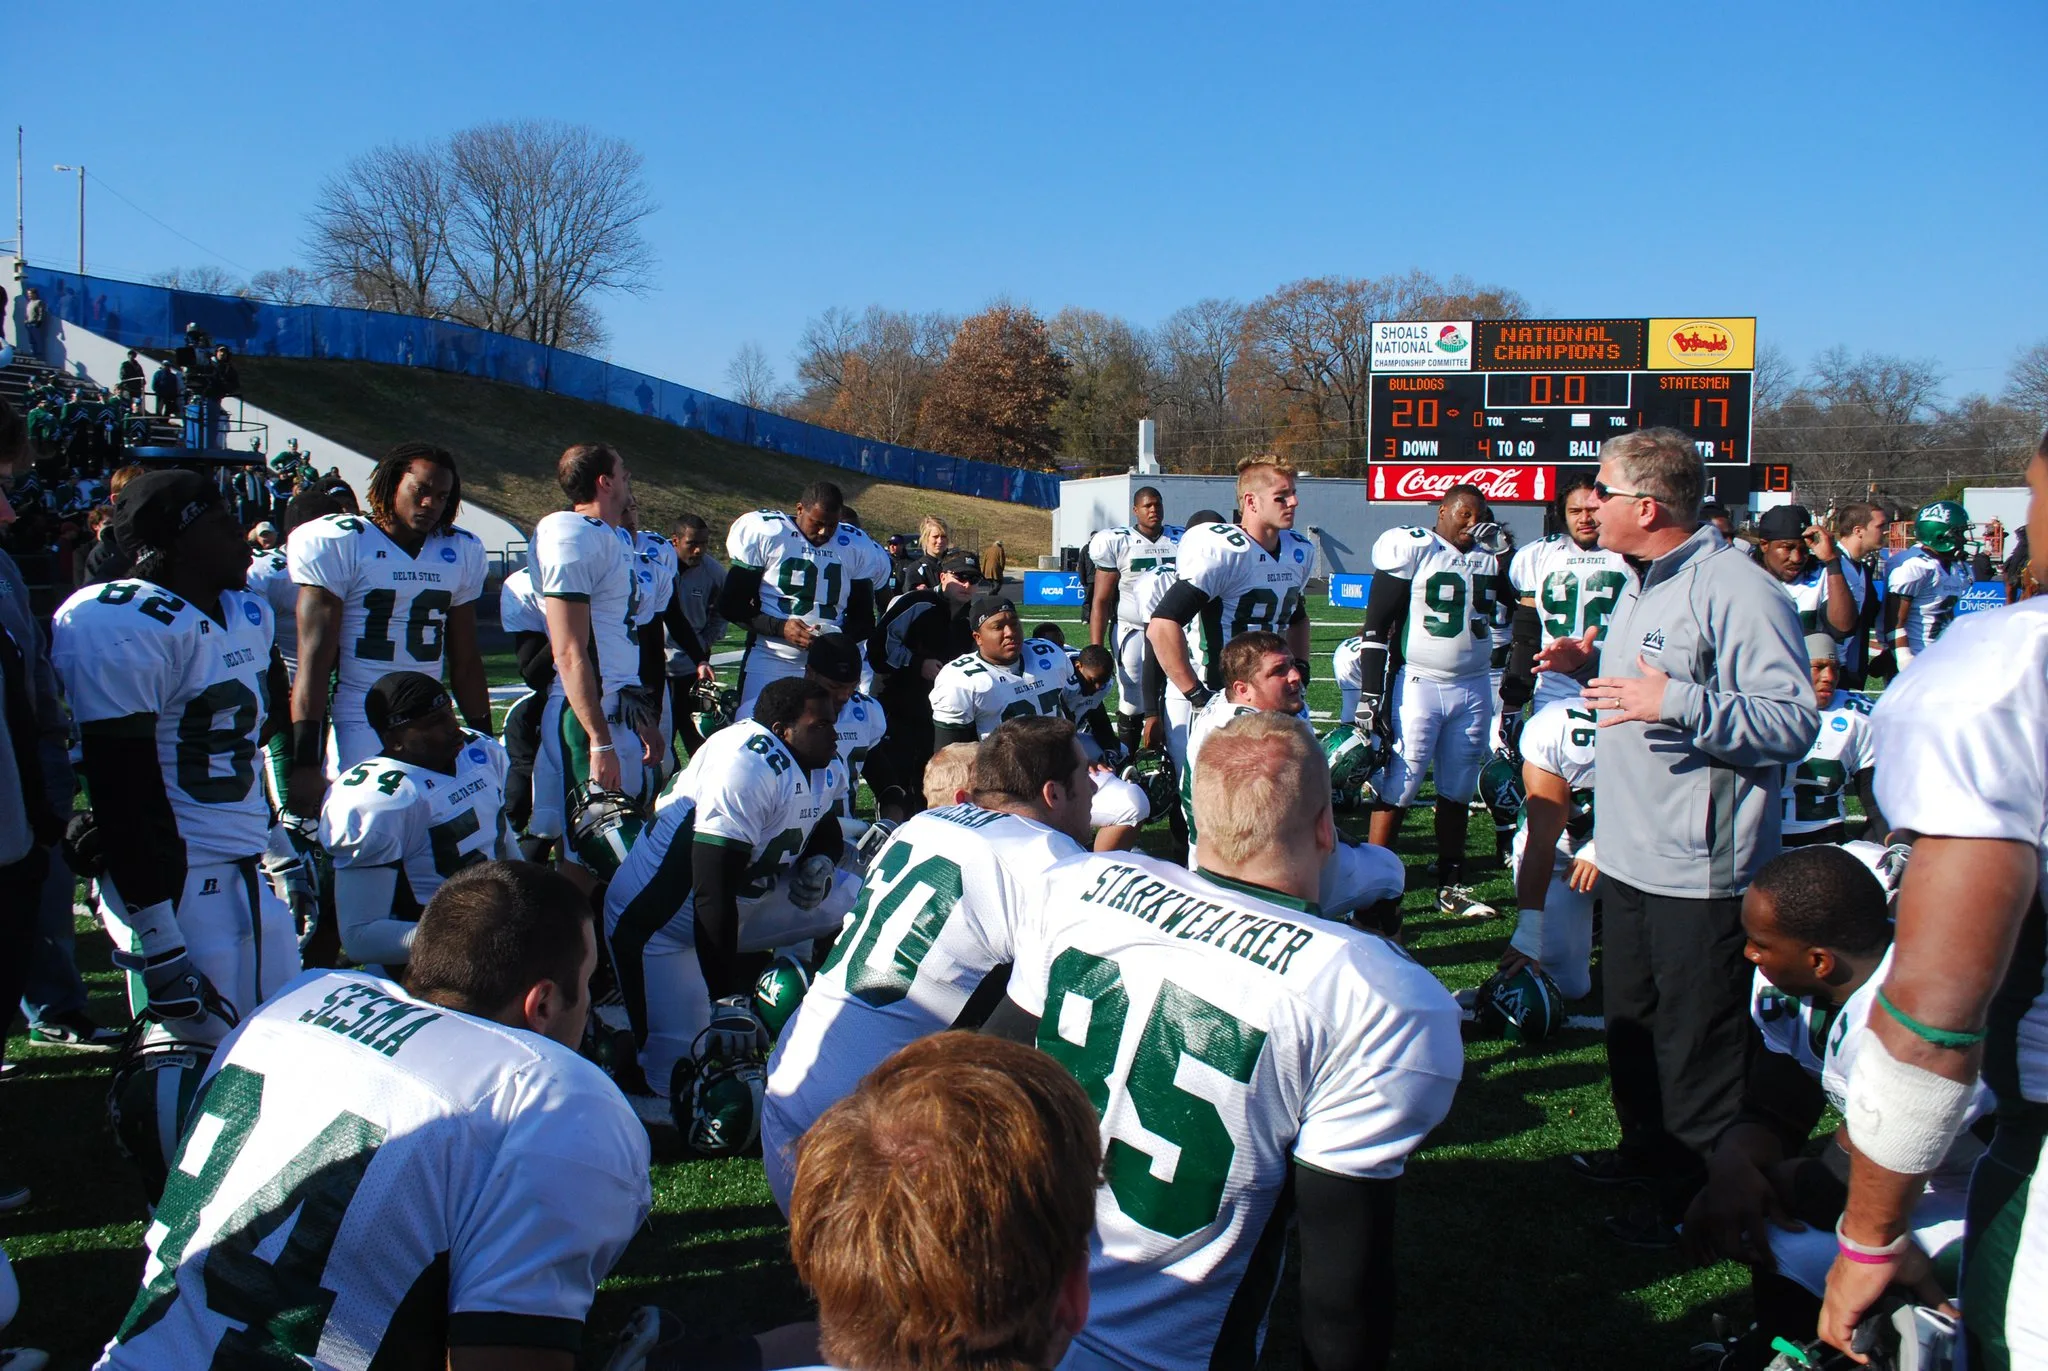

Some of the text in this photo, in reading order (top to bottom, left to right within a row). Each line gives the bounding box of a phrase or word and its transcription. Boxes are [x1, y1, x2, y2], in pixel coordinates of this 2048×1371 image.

[1381, 326, 1428, 339] SHOALS
[1501, 326, 1612, 342] NATIONAL
[1375, 341, 1433, 354] NATIONAL
[1494, 344, 1620, 360] CHAMPIONS
[1374, 358, 1468, 367] CHAMPIONSHIP COMMITTEE
[1389, 378, 1445, 391] BULLDOGS
[1659, 376, 1730, 390] STATESMEN
[1392, 399, 1438, 427] 20
[1487, 416, 1504, 426] TOL
[1609, 416, 1628, 426] TOL
[1693, 398, 1729, 428] 17
[1384, 438, 1439, 458] 3 DOWN
[1478, 438, 1535, 459] 4 TO GO
[1695, 439, 1734, 460] TR 4
[1764, 466, 1789, 491] 13
[393, 571, 441, 583] DELTA STATE
[778, 557, 842, 620] 91
[1041, 587, 1064, 595] NCAA
[1341, 583, 1363, 598] LEARNING
[97, 582, 186, 627] 82
[1423, 571, 1498, 640] 95
[1542, 570, 1628, 641] 92
[355, 588, 452, 662] 16
[952, 656, 988, 677] 97
[746, 734, 791, 776] 62
[343, 762, 408, 797] 54
[1080, 865, 1314, 976] STARKWEATHER
[298, 983, 445, 1058] SESMA
